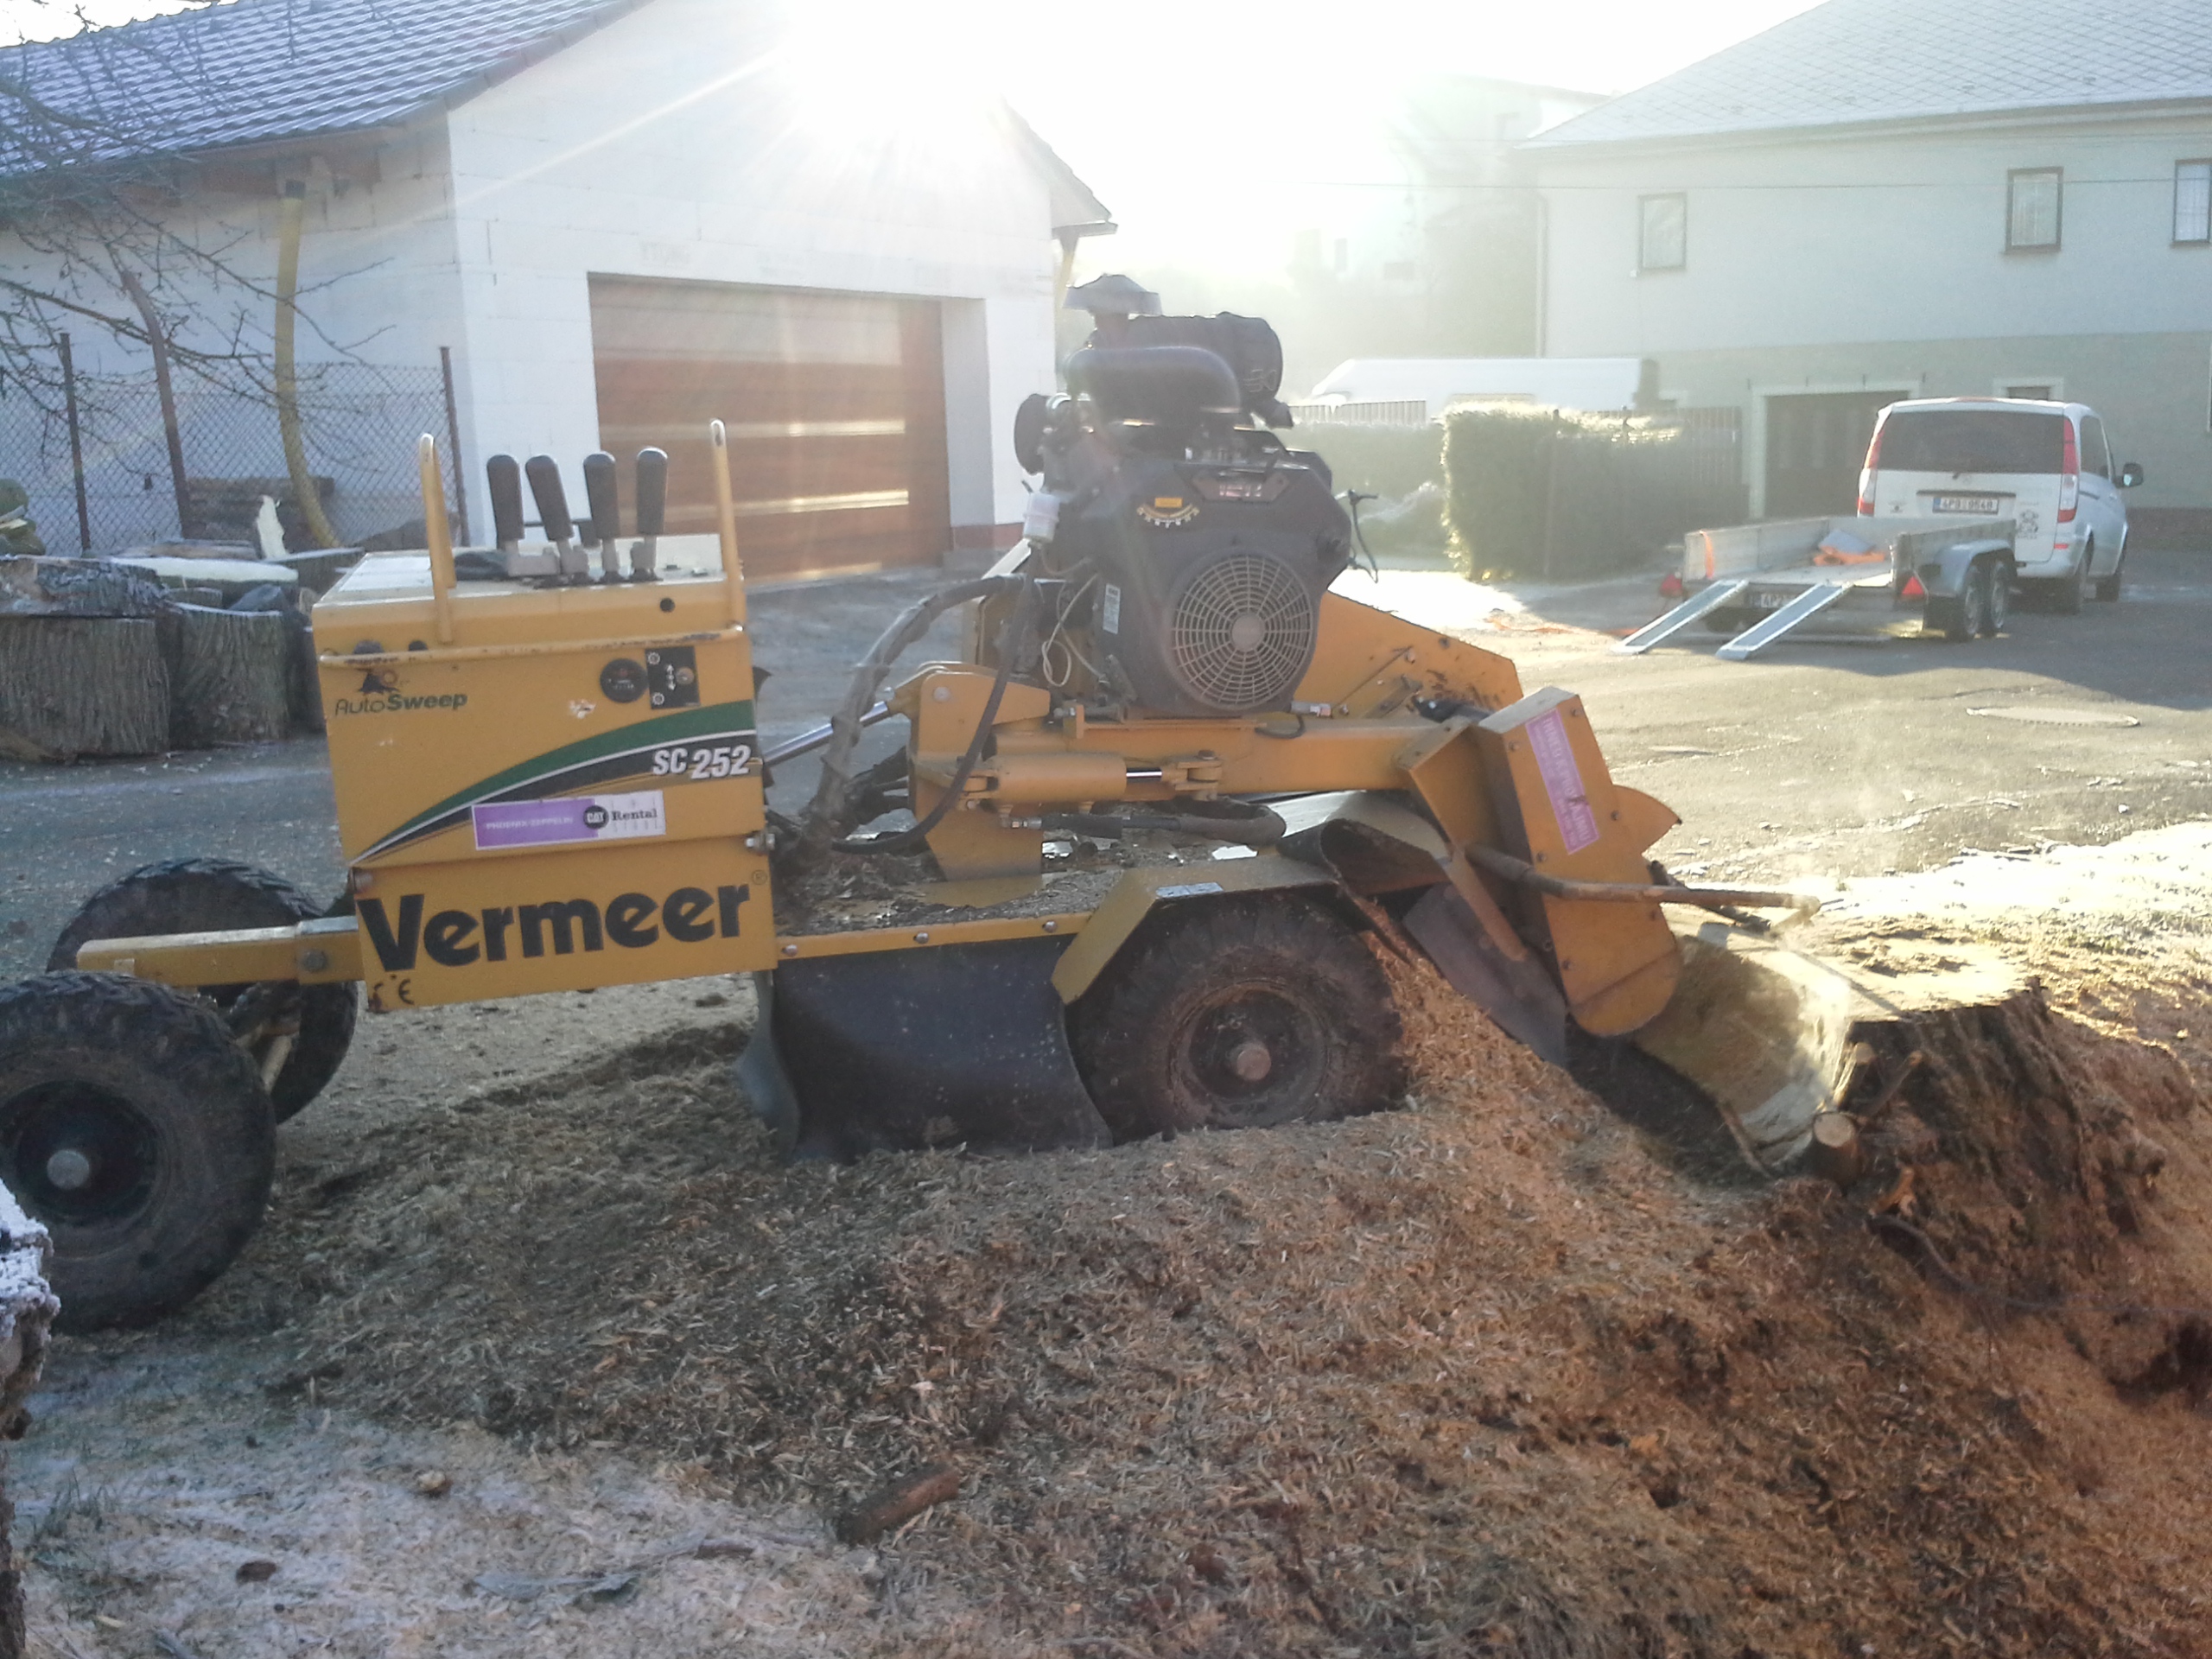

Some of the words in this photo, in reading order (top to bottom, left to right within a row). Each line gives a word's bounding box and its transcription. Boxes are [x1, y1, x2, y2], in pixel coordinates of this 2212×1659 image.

[334, 694, 467, 715] AutoSweep
[653, 747, 688, 775] SC
[692, 745, 752, 779] 252
[612, 809, 658, 821] Rental
[357, 884, 750, 972] Vermeer
